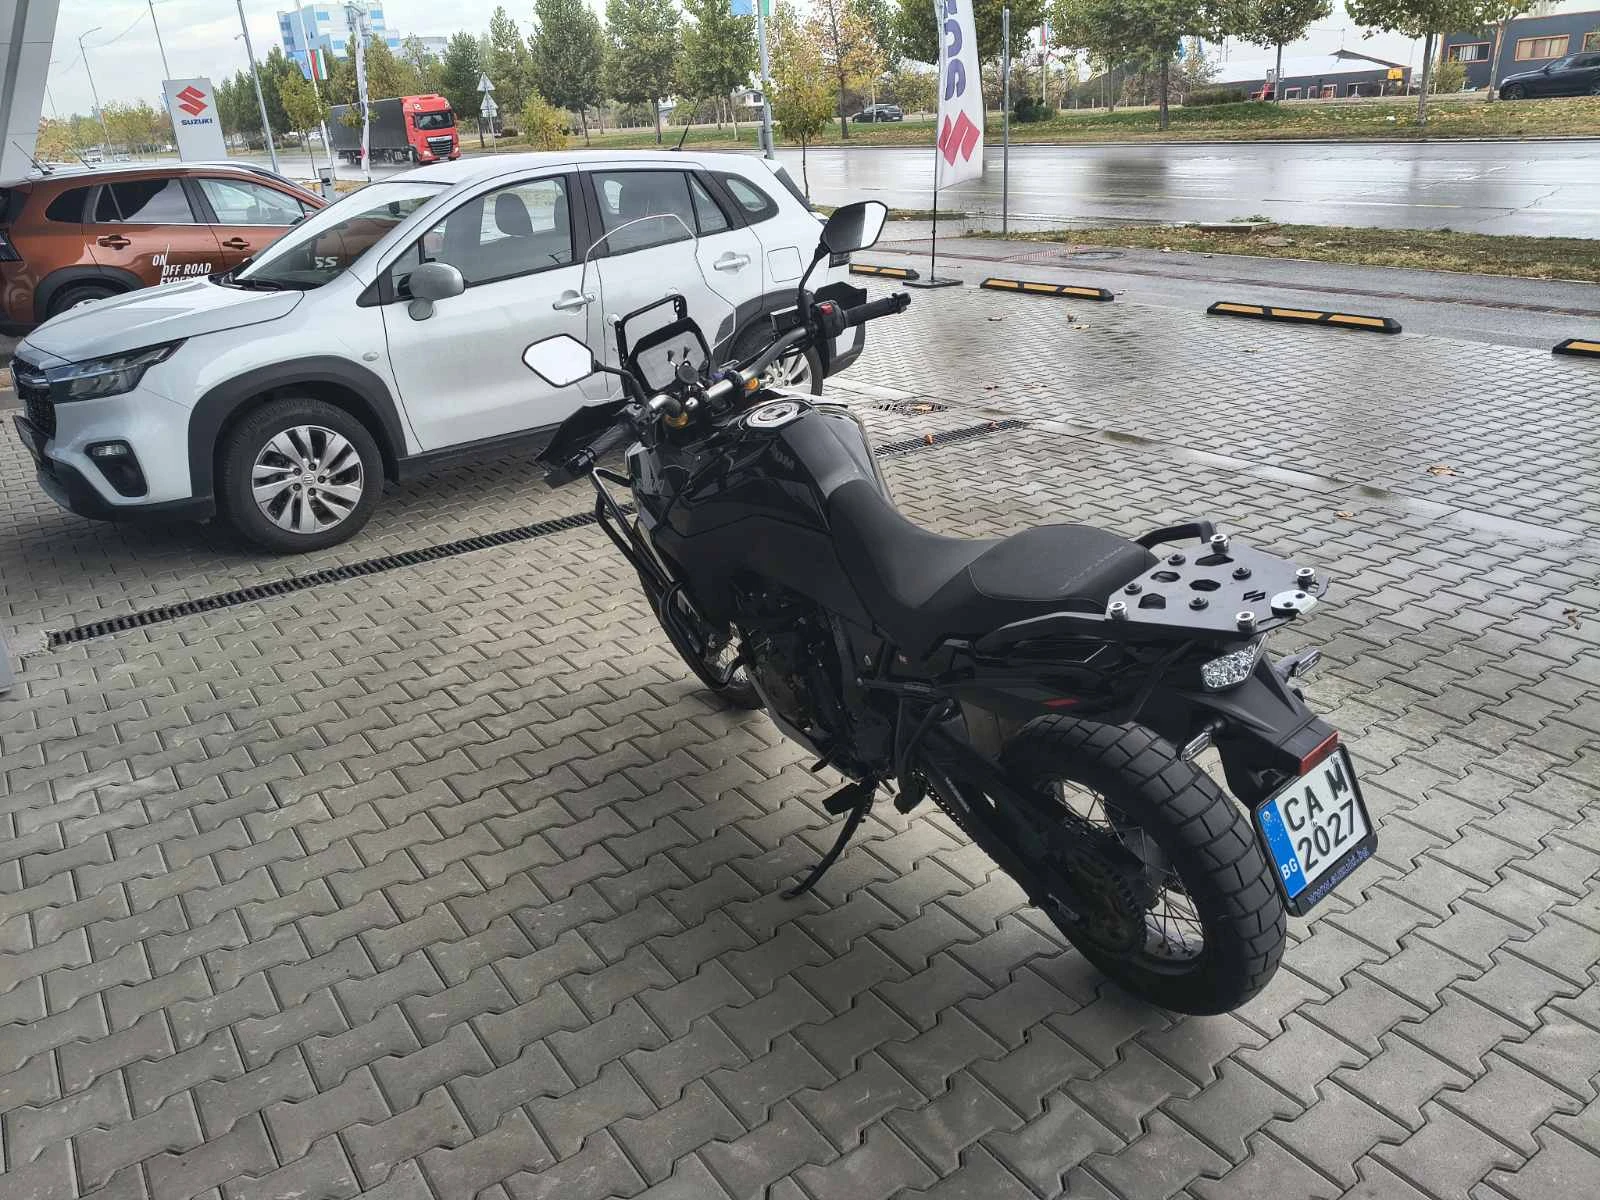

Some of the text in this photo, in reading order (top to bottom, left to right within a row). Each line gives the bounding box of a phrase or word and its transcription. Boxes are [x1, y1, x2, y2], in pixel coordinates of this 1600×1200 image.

[181, 118, 213, 126] SUZUKI
[162, 262, 212, 277] OFF ROAD
[1283, 762, 1349, 832] CA M
[1297, 798, 1355, 873] 2027
[1280, 857, 1299, 881] BG
